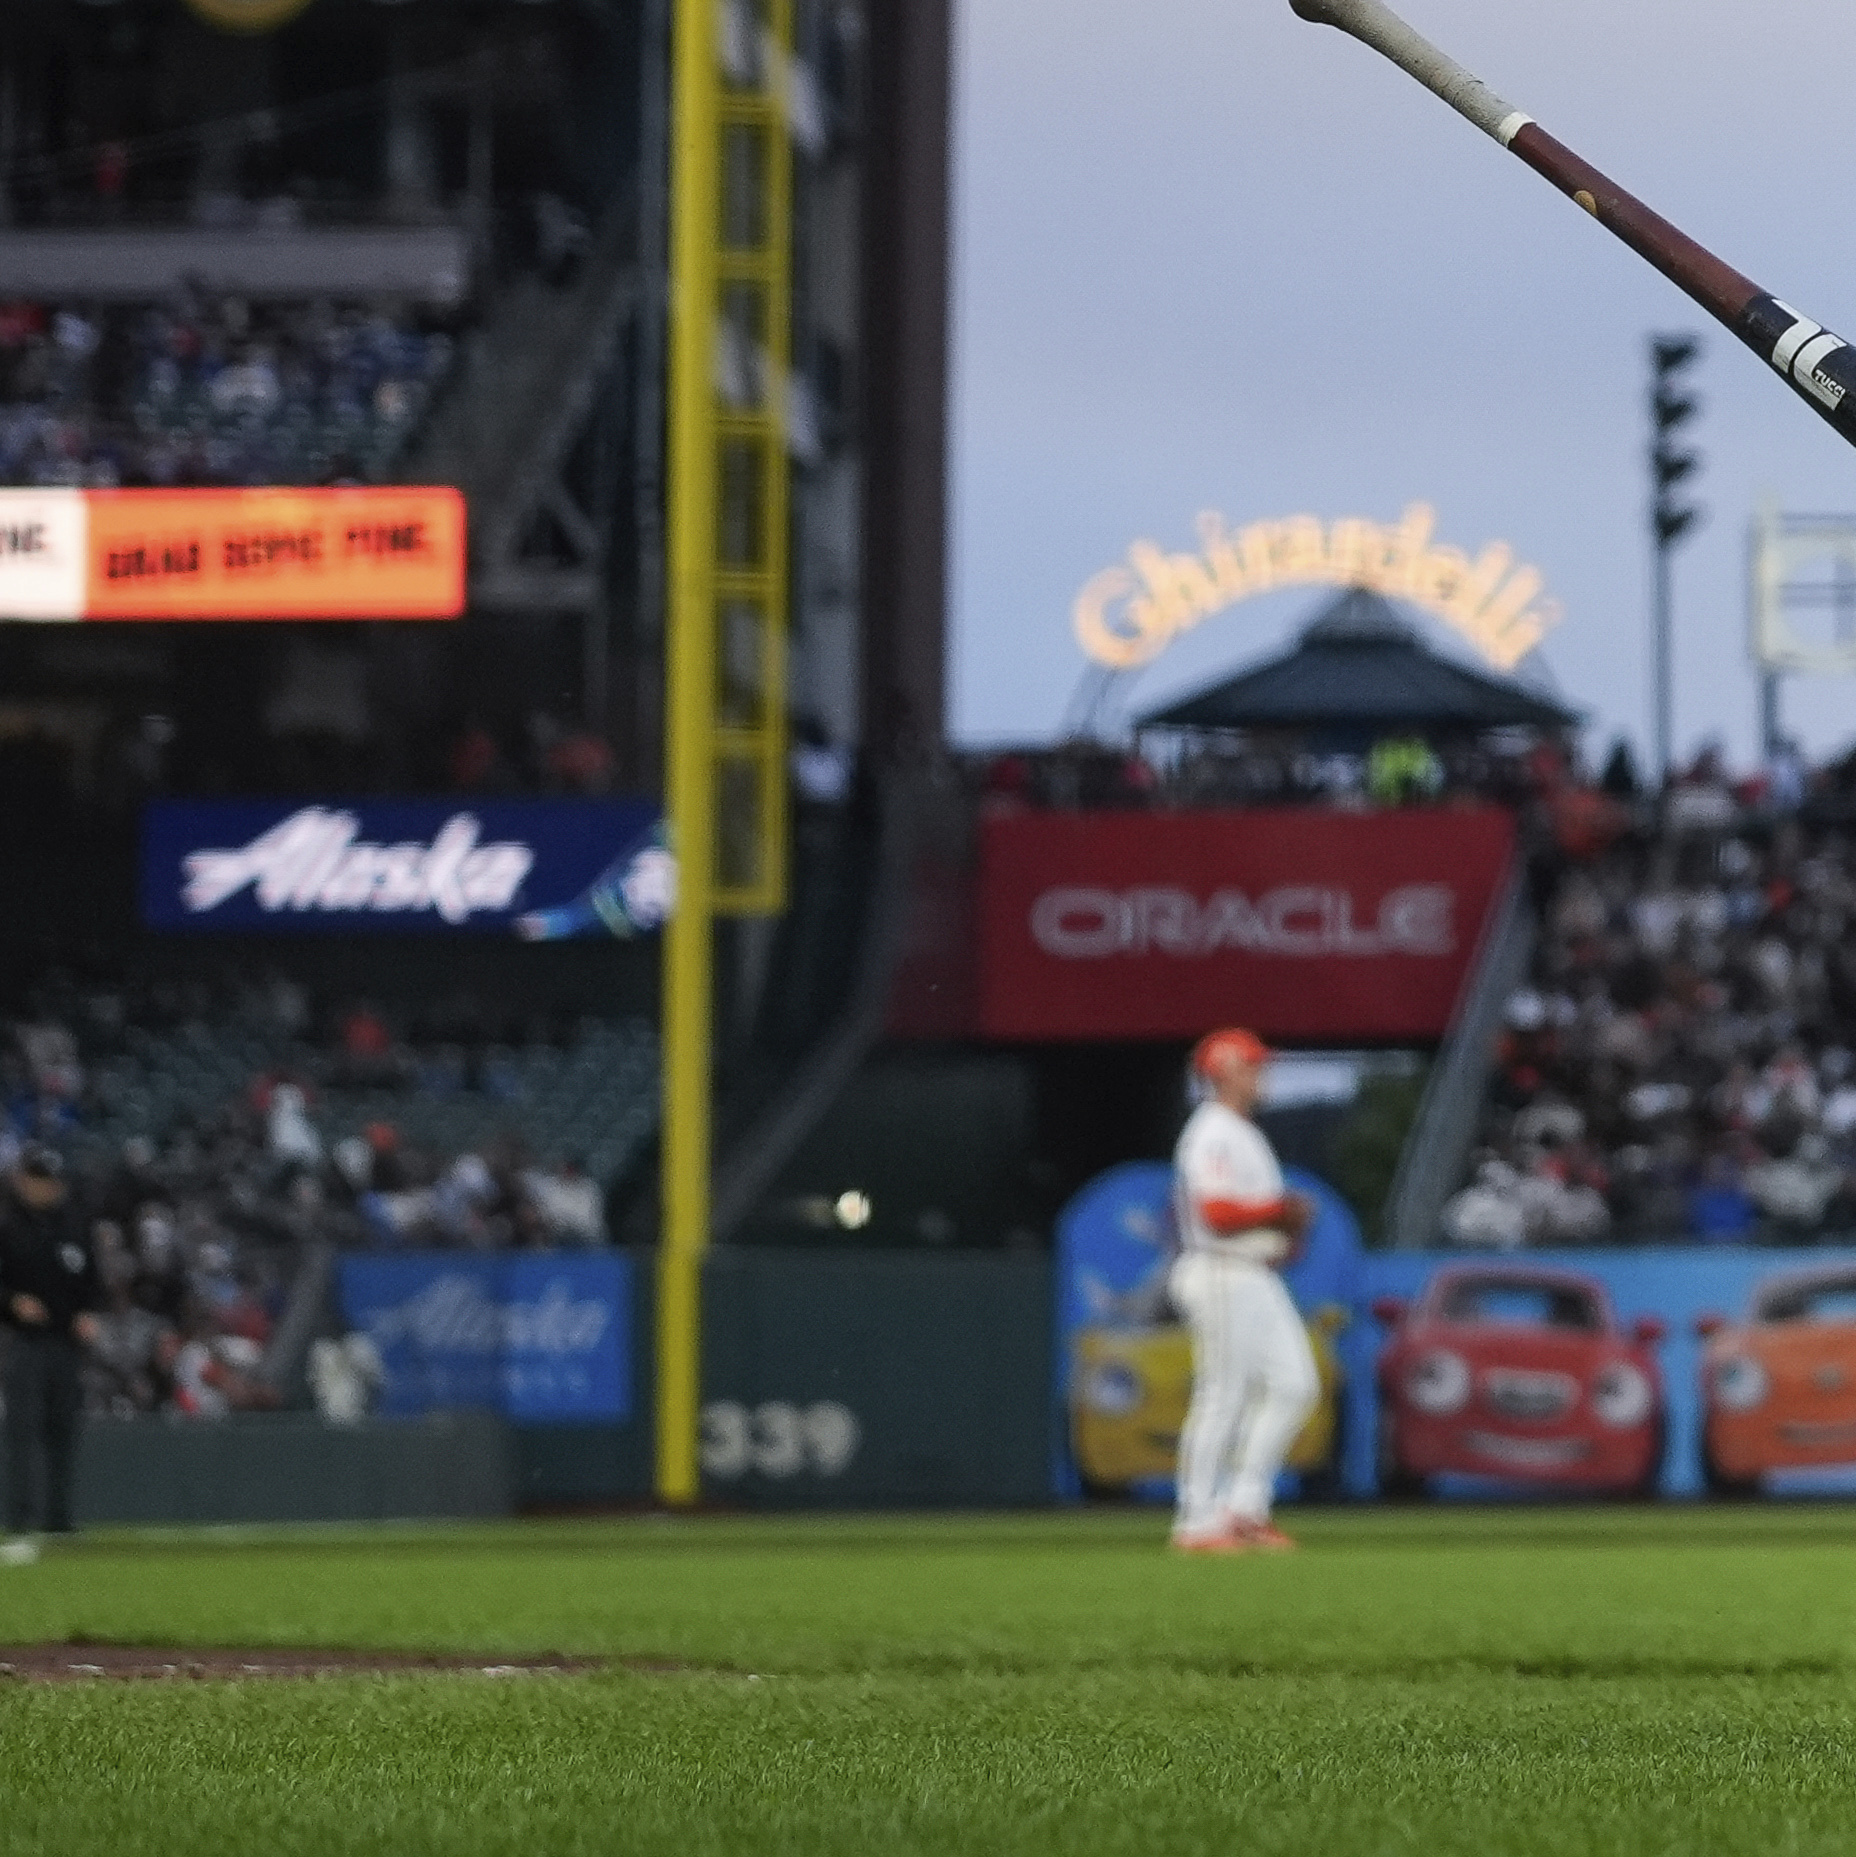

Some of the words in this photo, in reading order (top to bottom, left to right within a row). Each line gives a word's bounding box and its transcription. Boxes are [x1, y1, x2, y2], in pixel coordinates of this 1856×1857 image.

[1814, 369, 1846, 397] TUCCI
[1072, 501, 1564, 672] Ghirardelli
[180, 804, 536, 925] Alaska
[1030, 881, 1457, 957] ORACLE
[700, 1399, 862, 1477] 339
